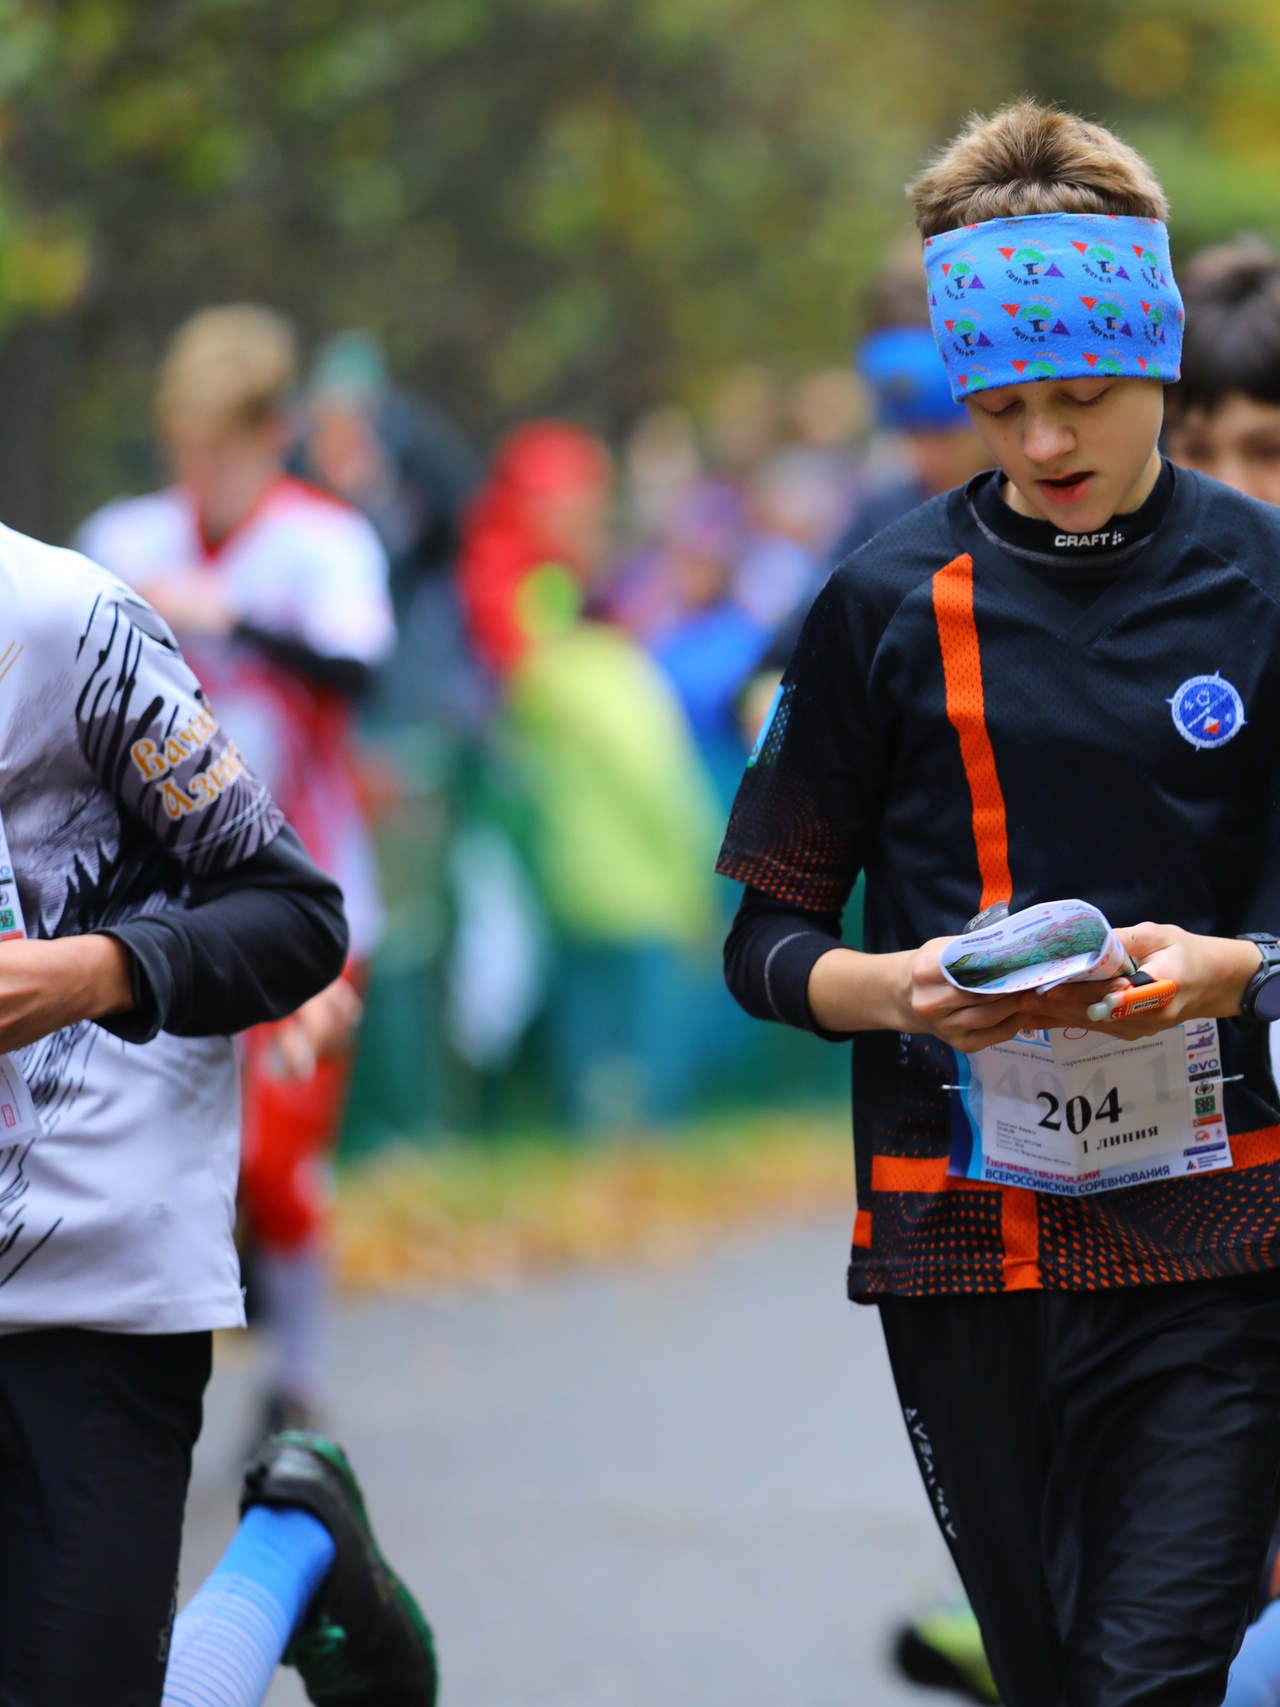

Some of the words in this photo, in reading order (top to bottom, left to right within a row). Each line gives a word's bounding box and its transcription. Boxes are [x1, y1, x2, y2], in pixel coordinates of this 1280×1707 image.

[1055, 533, 1110, 547] CRAFT
[1188, 1058, 1219, 1074] evo
[1036, 1086, 1123, 1136] 204
[1081, 1138, 1090, 1154] 1
[1097, 1124, 1160, 1152] линия
[1078, 1164, 1171, 1195] СОРЕВНОВАНИЯ
